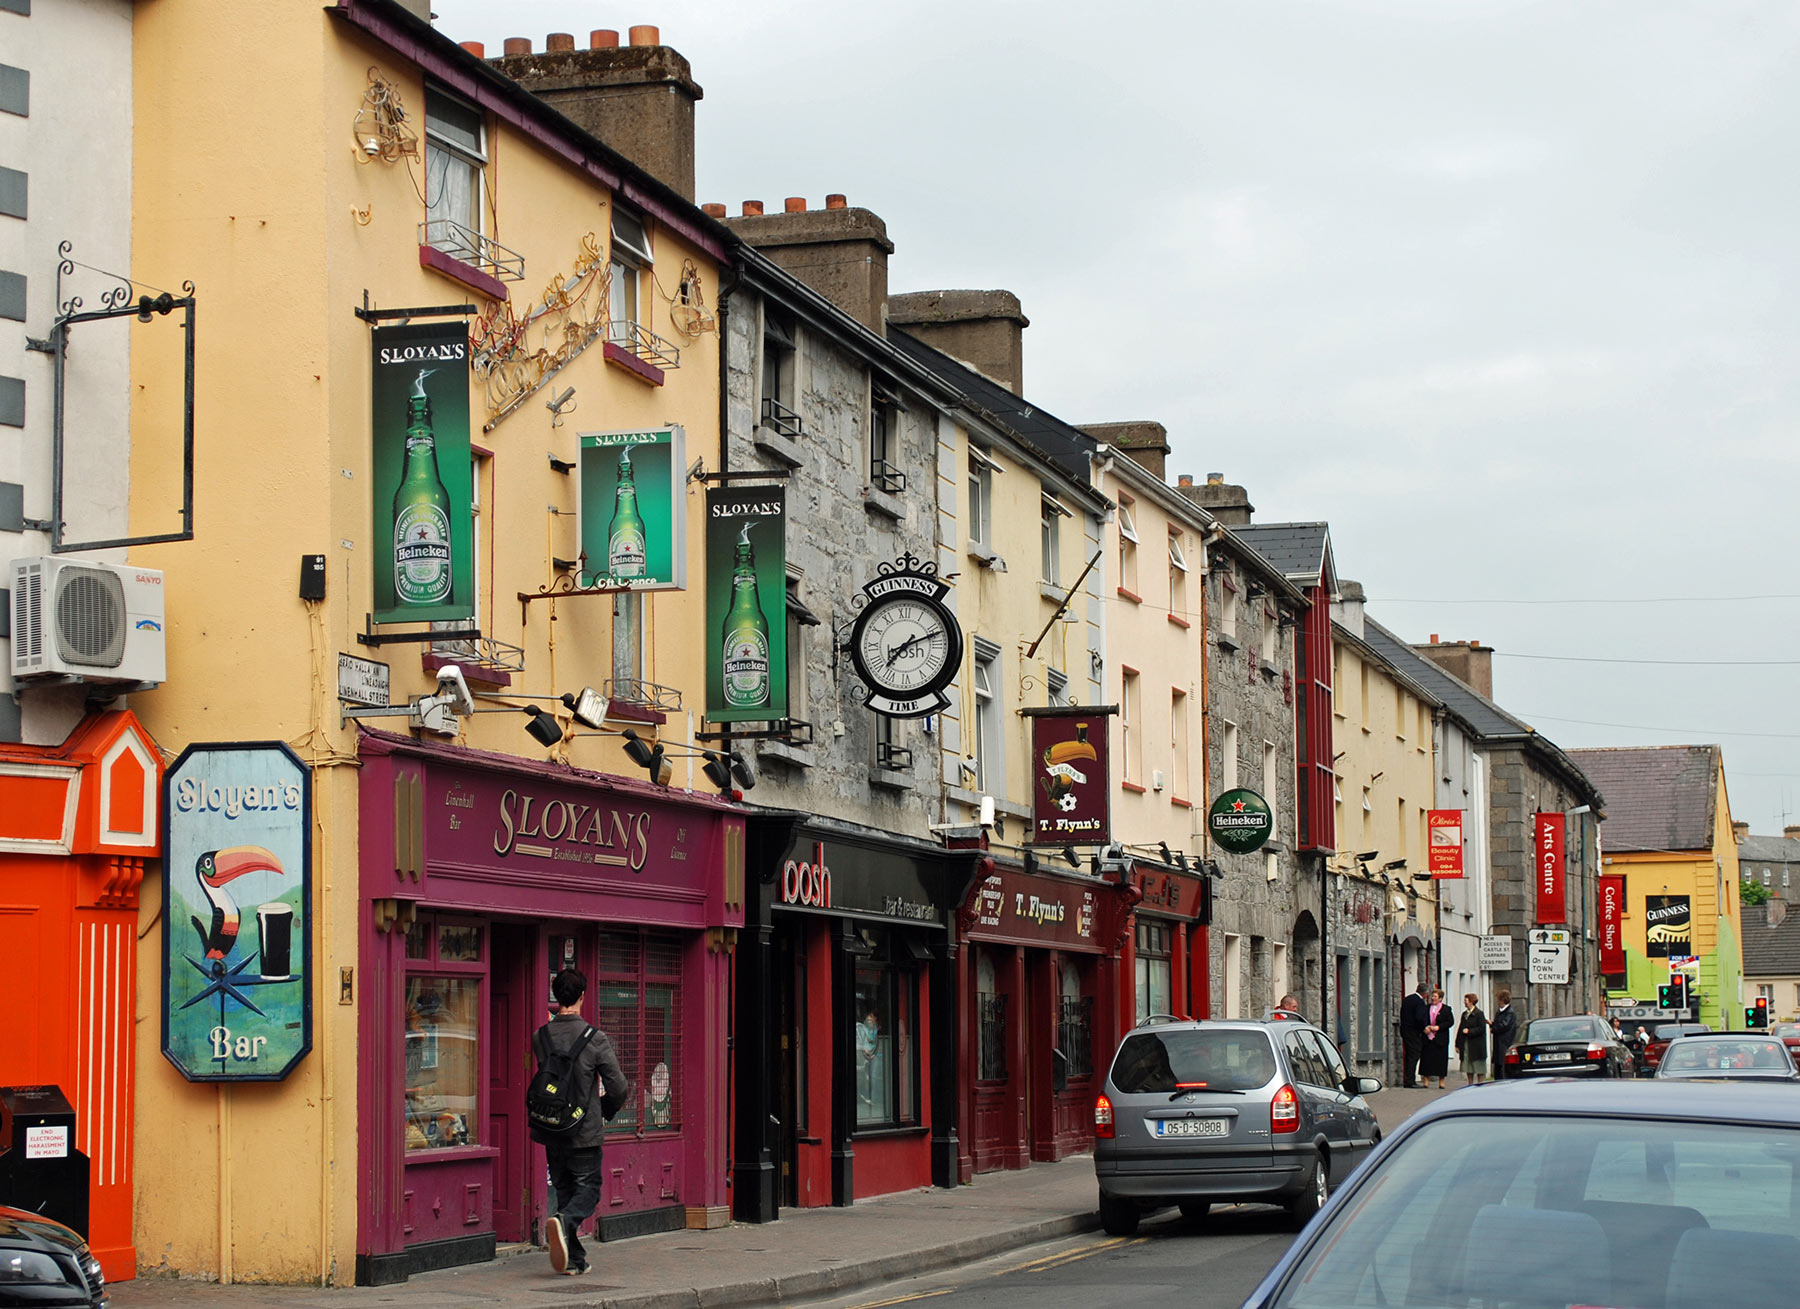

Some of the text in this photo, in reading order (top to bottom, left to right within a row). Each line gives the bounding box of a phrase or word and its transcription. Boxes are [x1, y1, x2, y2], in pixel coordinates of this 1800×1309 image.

[380, 343, 464, 364] SLOYAN'S
[712, 502, 781, 517] SLOYAN'S
[398, 545, 448, 561] Heineken
[135, 575, 161, 585] SANYO
[872, 578, 935, 597] GUINNESS
[898, 607, 911, 619] XII
[726, 661, 766, 673] Heineken
[339, 685, 389, 705] LINENHALL STREET
[889, 701, 919, 712] TIME
[177, 776, 300, 820] Sloyan's
[450, 814, 461, 830] Bar
[1040, 818, 1101, 833] T. Flynn's
[1216, 816, 1263, 826] Heineken
[494, 789, 650, 873] SLOYANS
[1544, 822, 1556, 894] Arts Centre
[1015, 893, 1064, 925] T. Flynn's
[1647, 904, 1689, 921] GUINNESS
[1604, 886, 1615, 950] Coffee Shop
[208, 1026, 268, 1062] Bar
[1167, 1122, 1221, 1134] 05-D-50808
